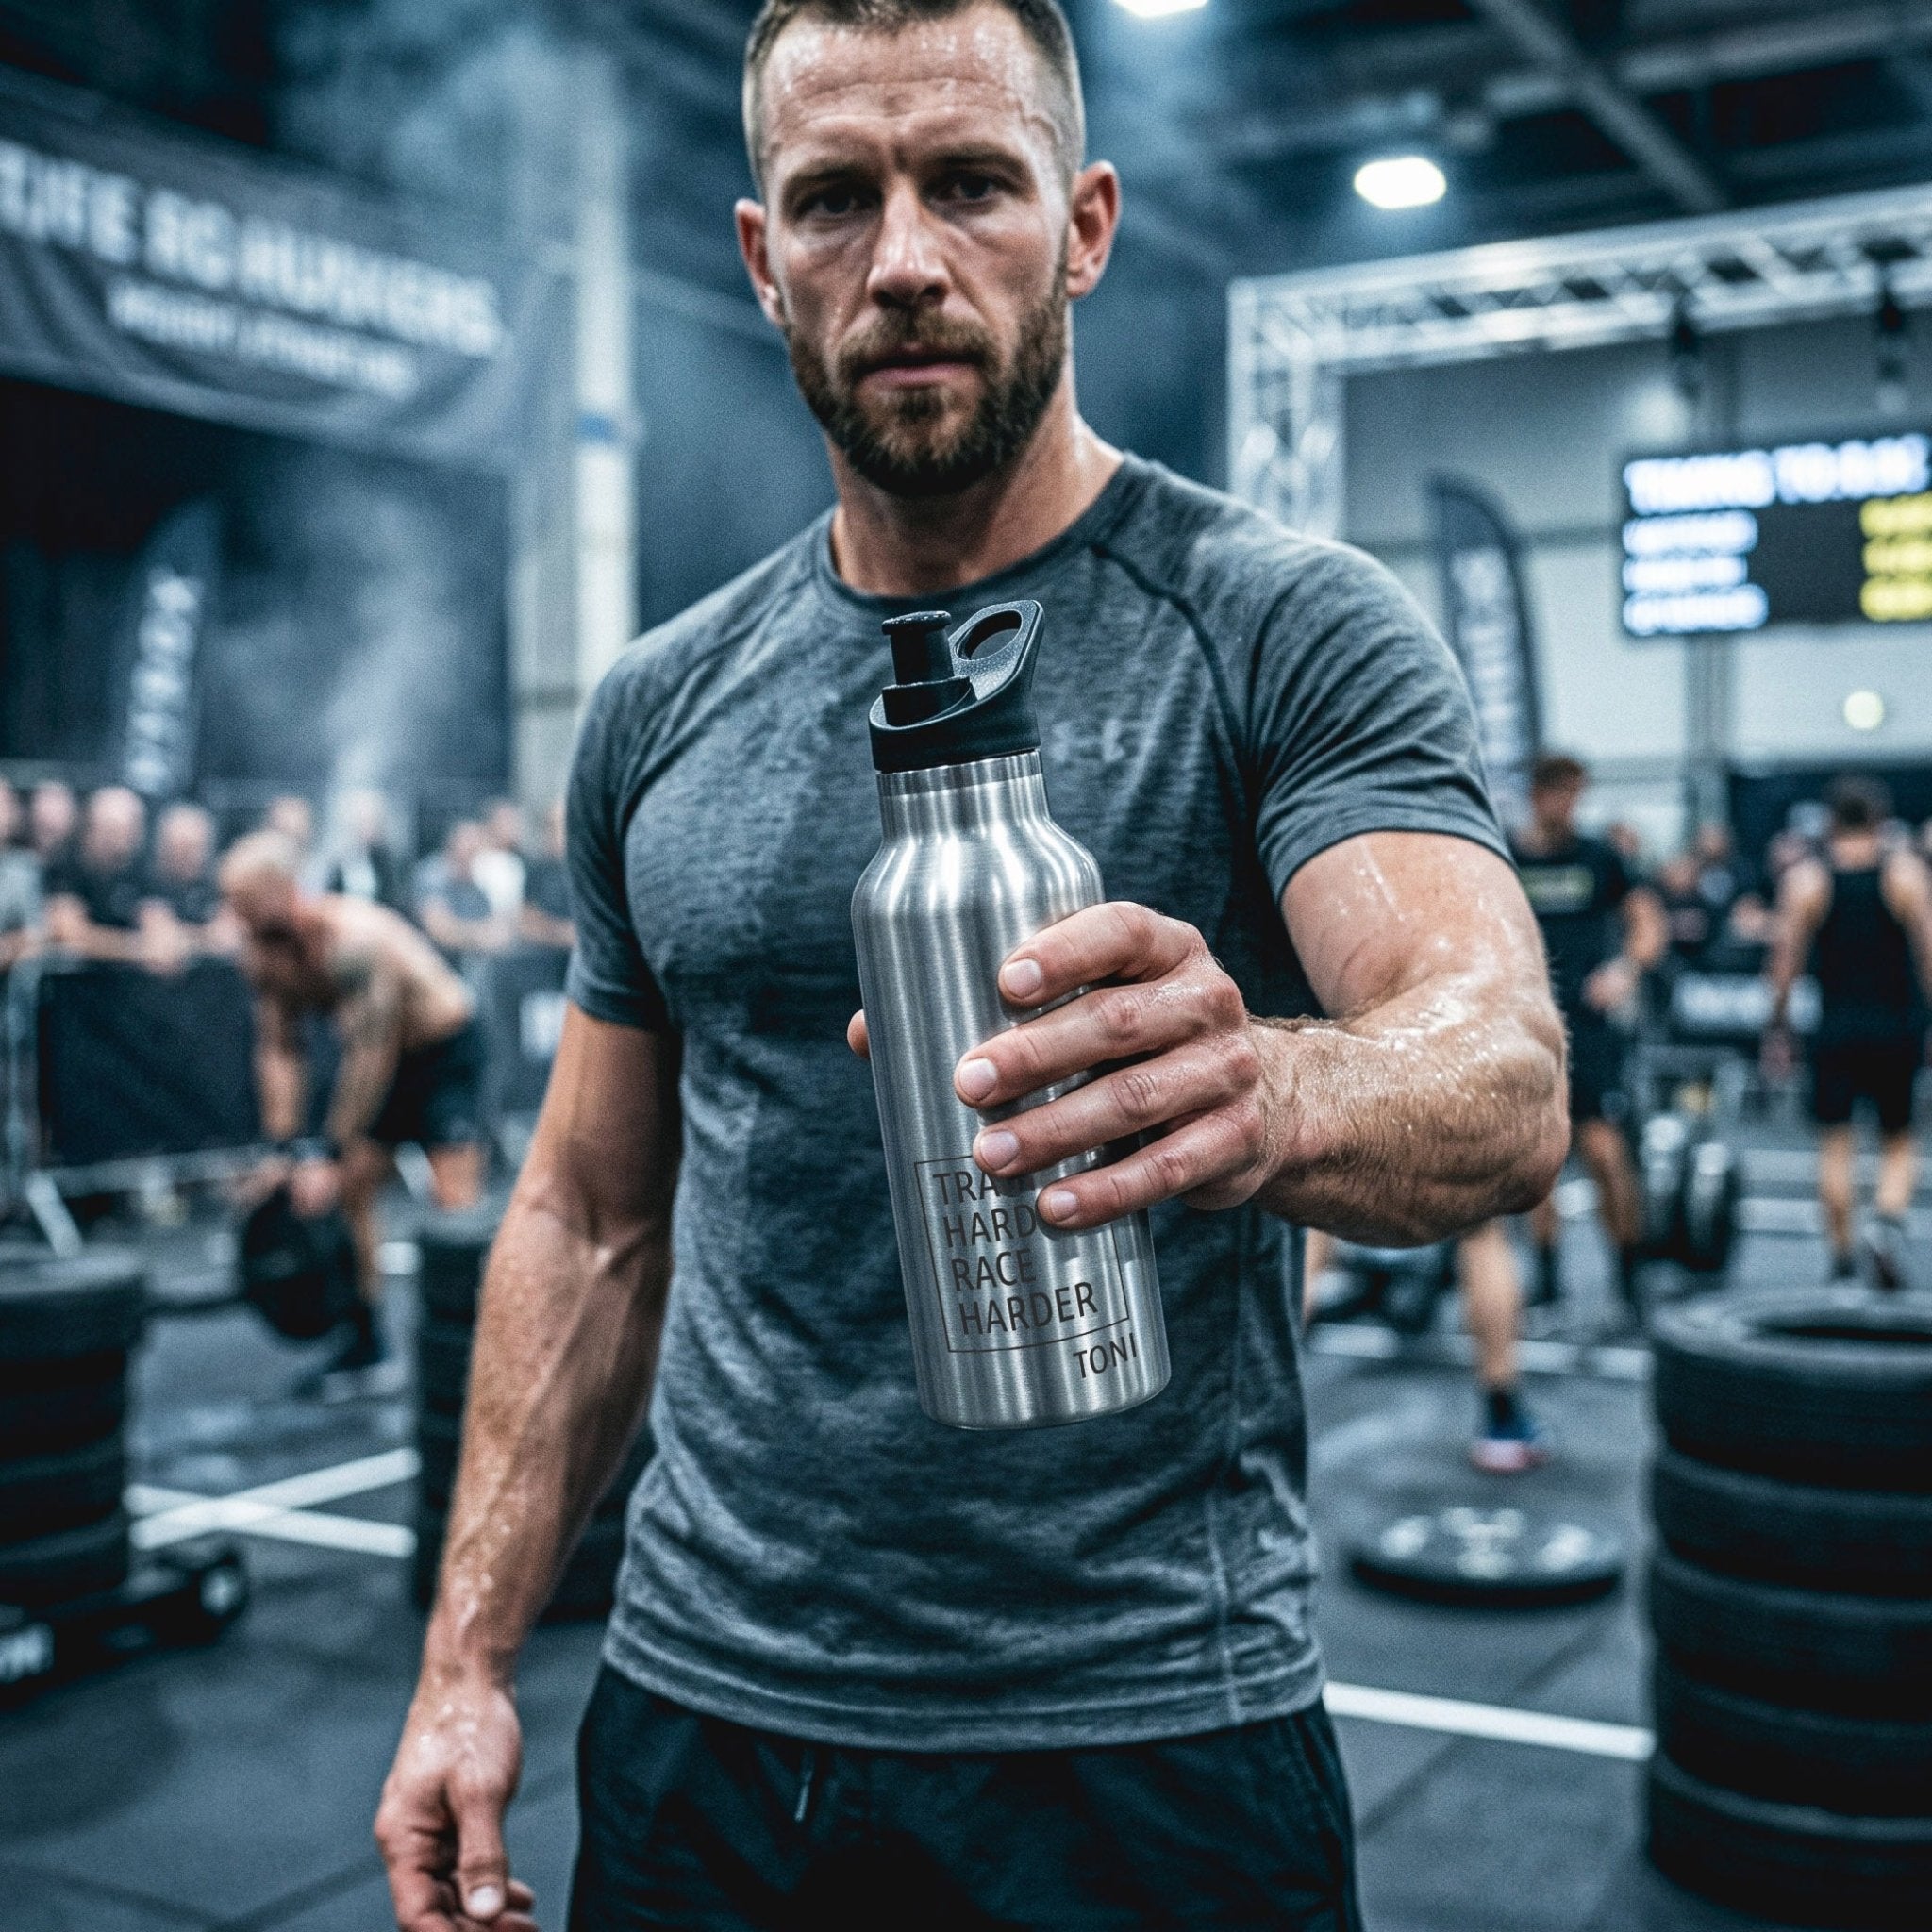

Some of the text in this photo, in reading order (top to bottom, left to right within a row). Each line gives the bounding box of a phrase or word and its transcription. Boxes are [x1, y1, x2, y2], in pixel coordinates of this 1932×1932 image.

[933, 1170, 1036, 1205] TRA
[943, 1204, 1037, 1248] HARD
[951, 1248, 1037, 1291] RACE
[958, 1281, 1099, 1335] HARDER
[1073, 1332, 1137, 1379] TONI
